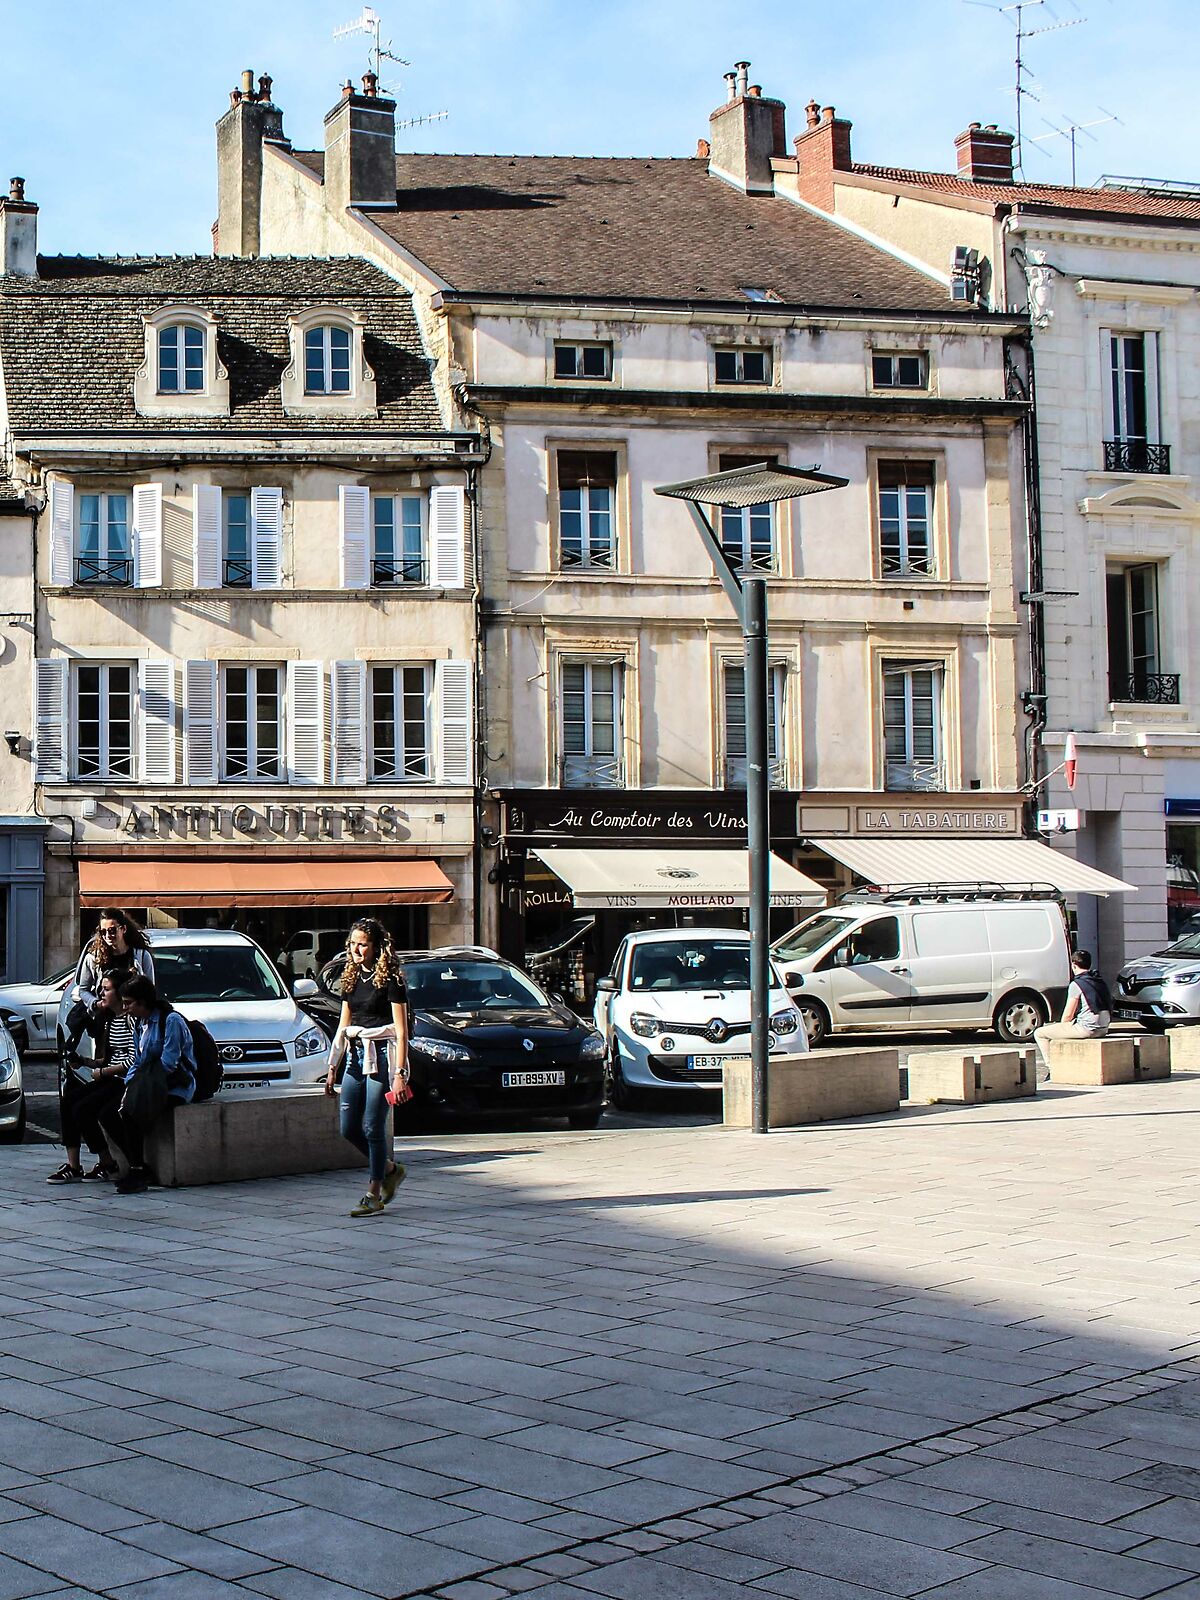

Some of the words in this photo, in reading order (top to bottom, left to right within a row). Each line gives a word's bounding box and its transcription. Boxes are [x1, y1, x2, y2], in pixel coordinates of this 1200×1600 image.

[122, 803, 400, 834] ANTIQUITES
[549, 809, 583, 827] Au
[590, 810, 661, 830] Comptoir
[667, 811, 694, 828] des
[703, 811, 749, 828] Vins
[865, 812, 890, 828] LA
[900, 812, 1009, 829] TABATIERE
[524, 892, 572, 908] MOILLA
[606, 895, 637, 907] VINS
[668, 895, 735, 906] MOILLARD
[769, 894, 803, 906] INES
